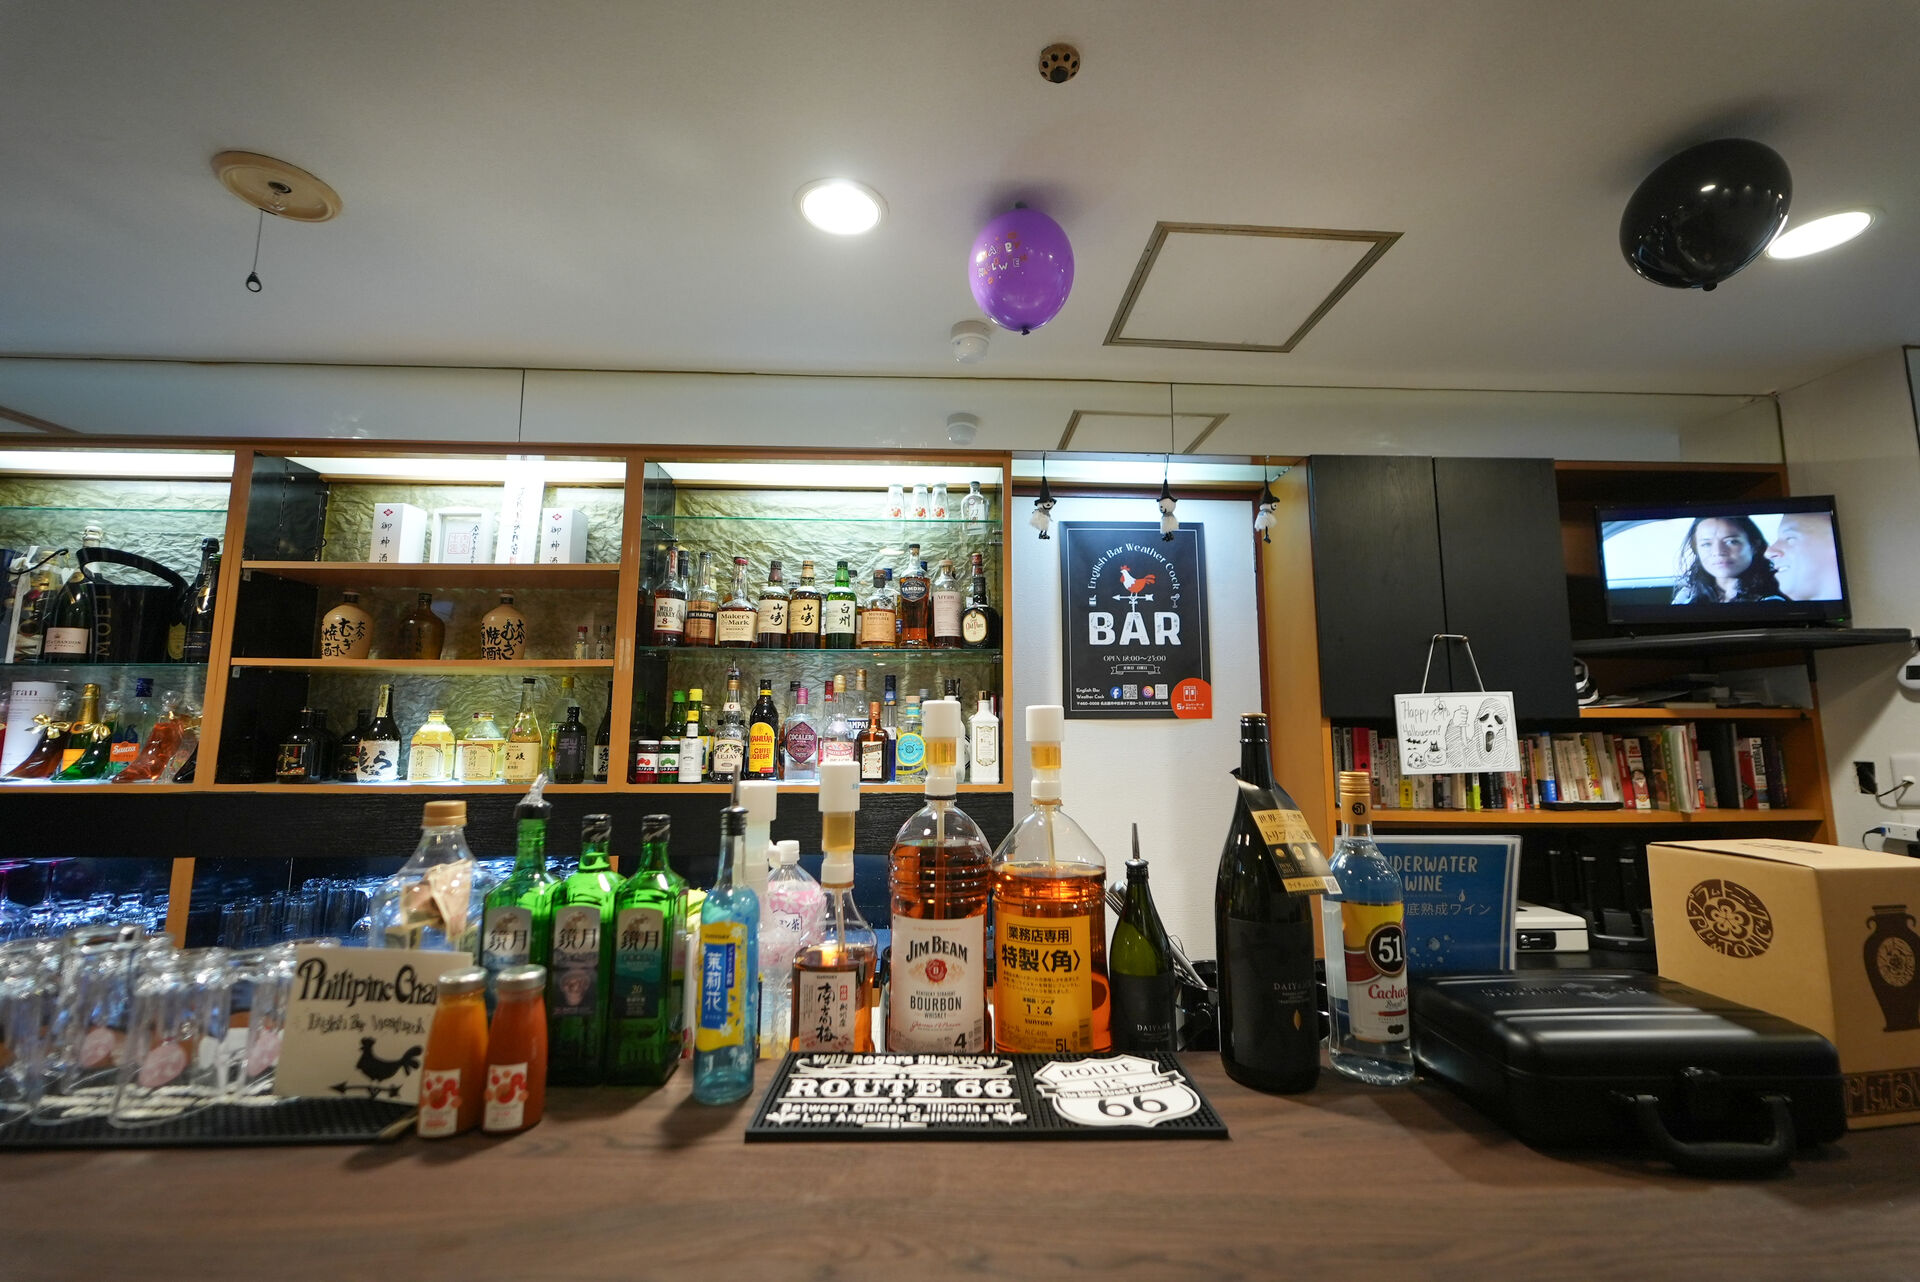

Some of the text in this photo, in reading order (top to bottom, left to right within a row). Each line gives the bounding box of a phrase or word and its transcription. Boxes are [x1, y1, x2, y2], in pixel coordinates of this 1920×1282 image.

[1088, 543, 1181, 590] English Bar Weather Cock
[770, 604, 784, 626] 山崎
[801, 604, 815, 626] 山崎
[839, 603, 851, 627] 白州
[1088, 612, 1182, 645] BAR
[13, 689, 38, 697] rran
[1400, 700, 1430, 724] Happy
[1385, 855, 1478, 873] NDERWATER
[1405, 875, 1443, 892] WINE
[1406, 902, 1492, 916] 底熟成ワイン
[488, 928, 528, 951] 鏡月
[556, 927, 597, 950] 鏡月
[620, 929, 661, 951] 鏡月
[1008, 926, 1070, 943] 業務店専用
[906, 935, 968, 964] JIM BEAM
[1378, 935, 1403, 963] 51
[705, 951, 723, 1012] 茉莉花
[815, 982, 838, 1044] 南高梅
[910, 996, 962, 1012] BOURBON
[924, 1011, 947, 1019] WHISKEY
[1024, 1018, 1053, 1027] SUNTORY
[953, 1033, 968, 1049] 4
[1055, 1038, 1071, 1053] 5L
[813, 1054, 999, 1067] Will Rogers Highway
[1059, 1063, 1137, 1079] ROUTE
[785, 1078, 1014, 1098] ROUTE 66
[1078, 1090, 1101, 1098] Main
[1101, 1088, 1128, 1097] Street
[1139, 1081, 1173, 1092] America
[1093, 1078, 1129, 1090] US
[781, 1102, 1015, 1115] Between Chicago, Illinois and
[1097, 1095, 1169, 1118] 66
[801, 1112, 990, 1125] Los Angeles, California
